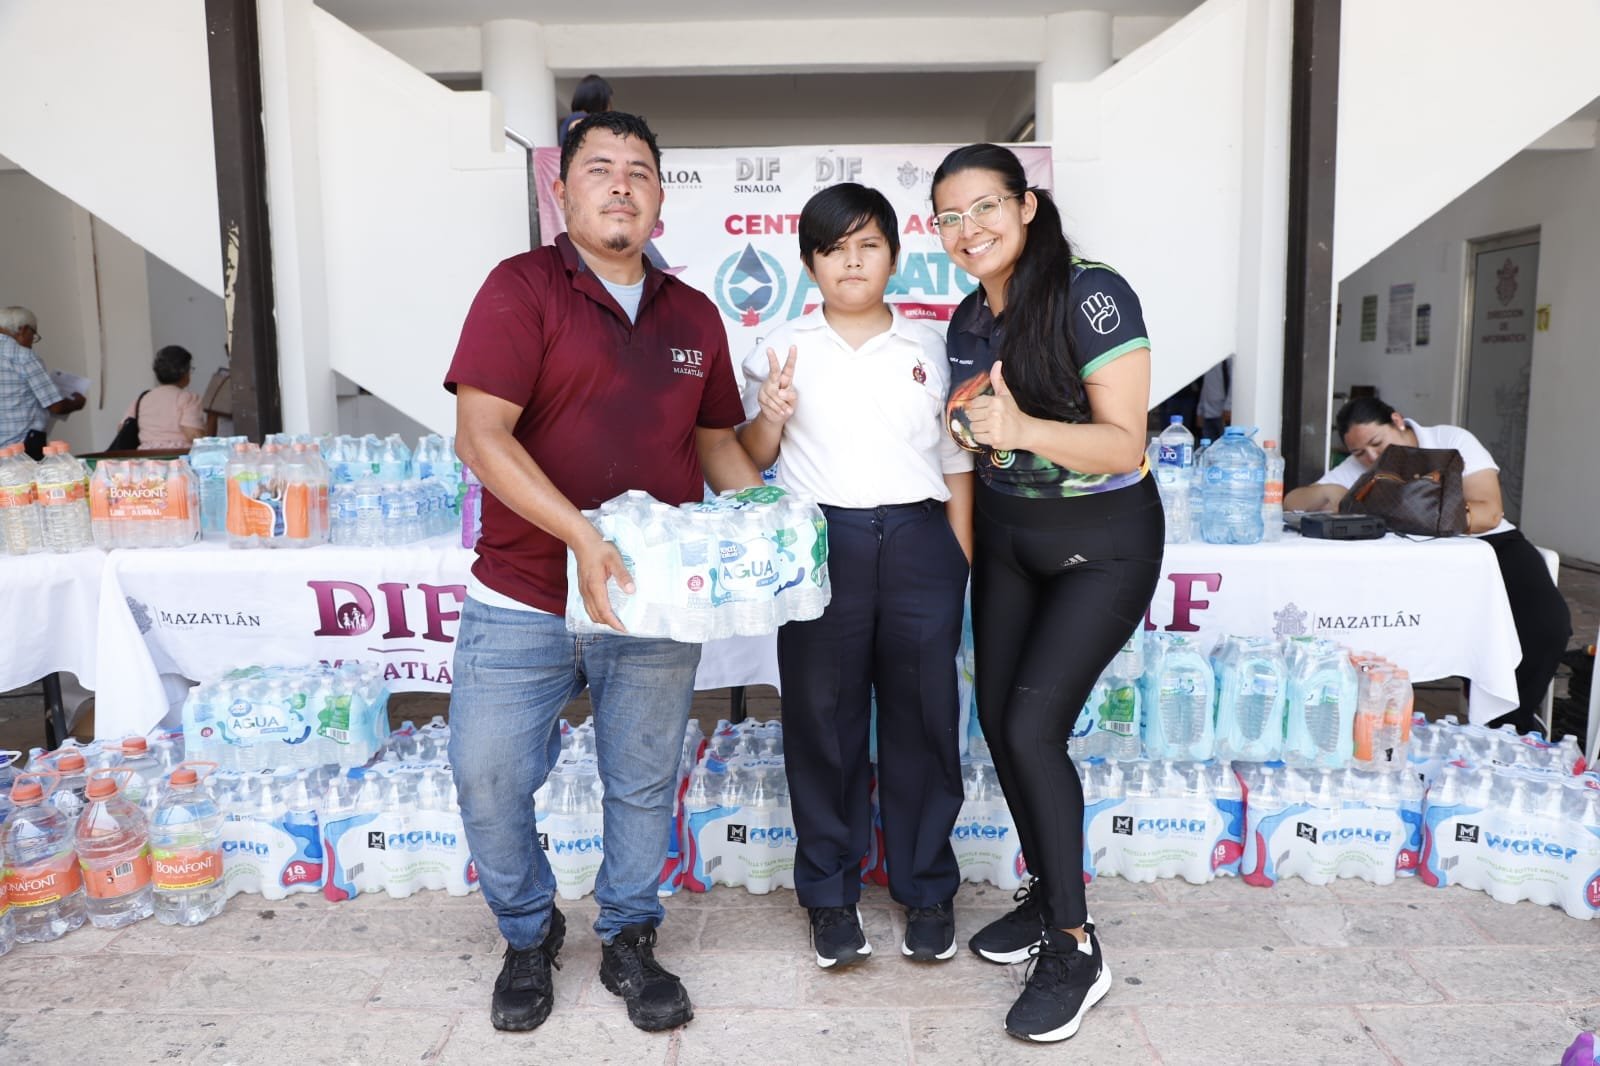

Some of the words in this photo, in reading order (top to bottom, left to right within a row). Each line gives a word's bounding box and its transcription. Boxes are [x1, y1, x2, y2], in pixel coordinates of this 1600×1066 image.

[735, 157, 781, 182] DIF
[815, 156, 863, 182] DIF
[734, 184, 782, 194] SINALOA
[725, 214, 800, 236] CENT
[670, 348, 703, 366] DIF
[110, 486, 166, 498] BONAFONT
[723, 559, 773, 581] AGUA
[160, 610, 261, 627] MAZATLÁN
[307, 580, 468, 644] DIF
[1317, 610, 1421, 630] MAZATLÁN
[232, 716, 280, 729] AGUA
[1137, 818, 1206, 839] agua
[1321, 827, 1392, 846] agua
[388, 831, 458, 853] agua
[1484, 831, 1578, 862] water
[156, 855, 214, 874] BONAFONT
[287, 865, 306, 877] 18
